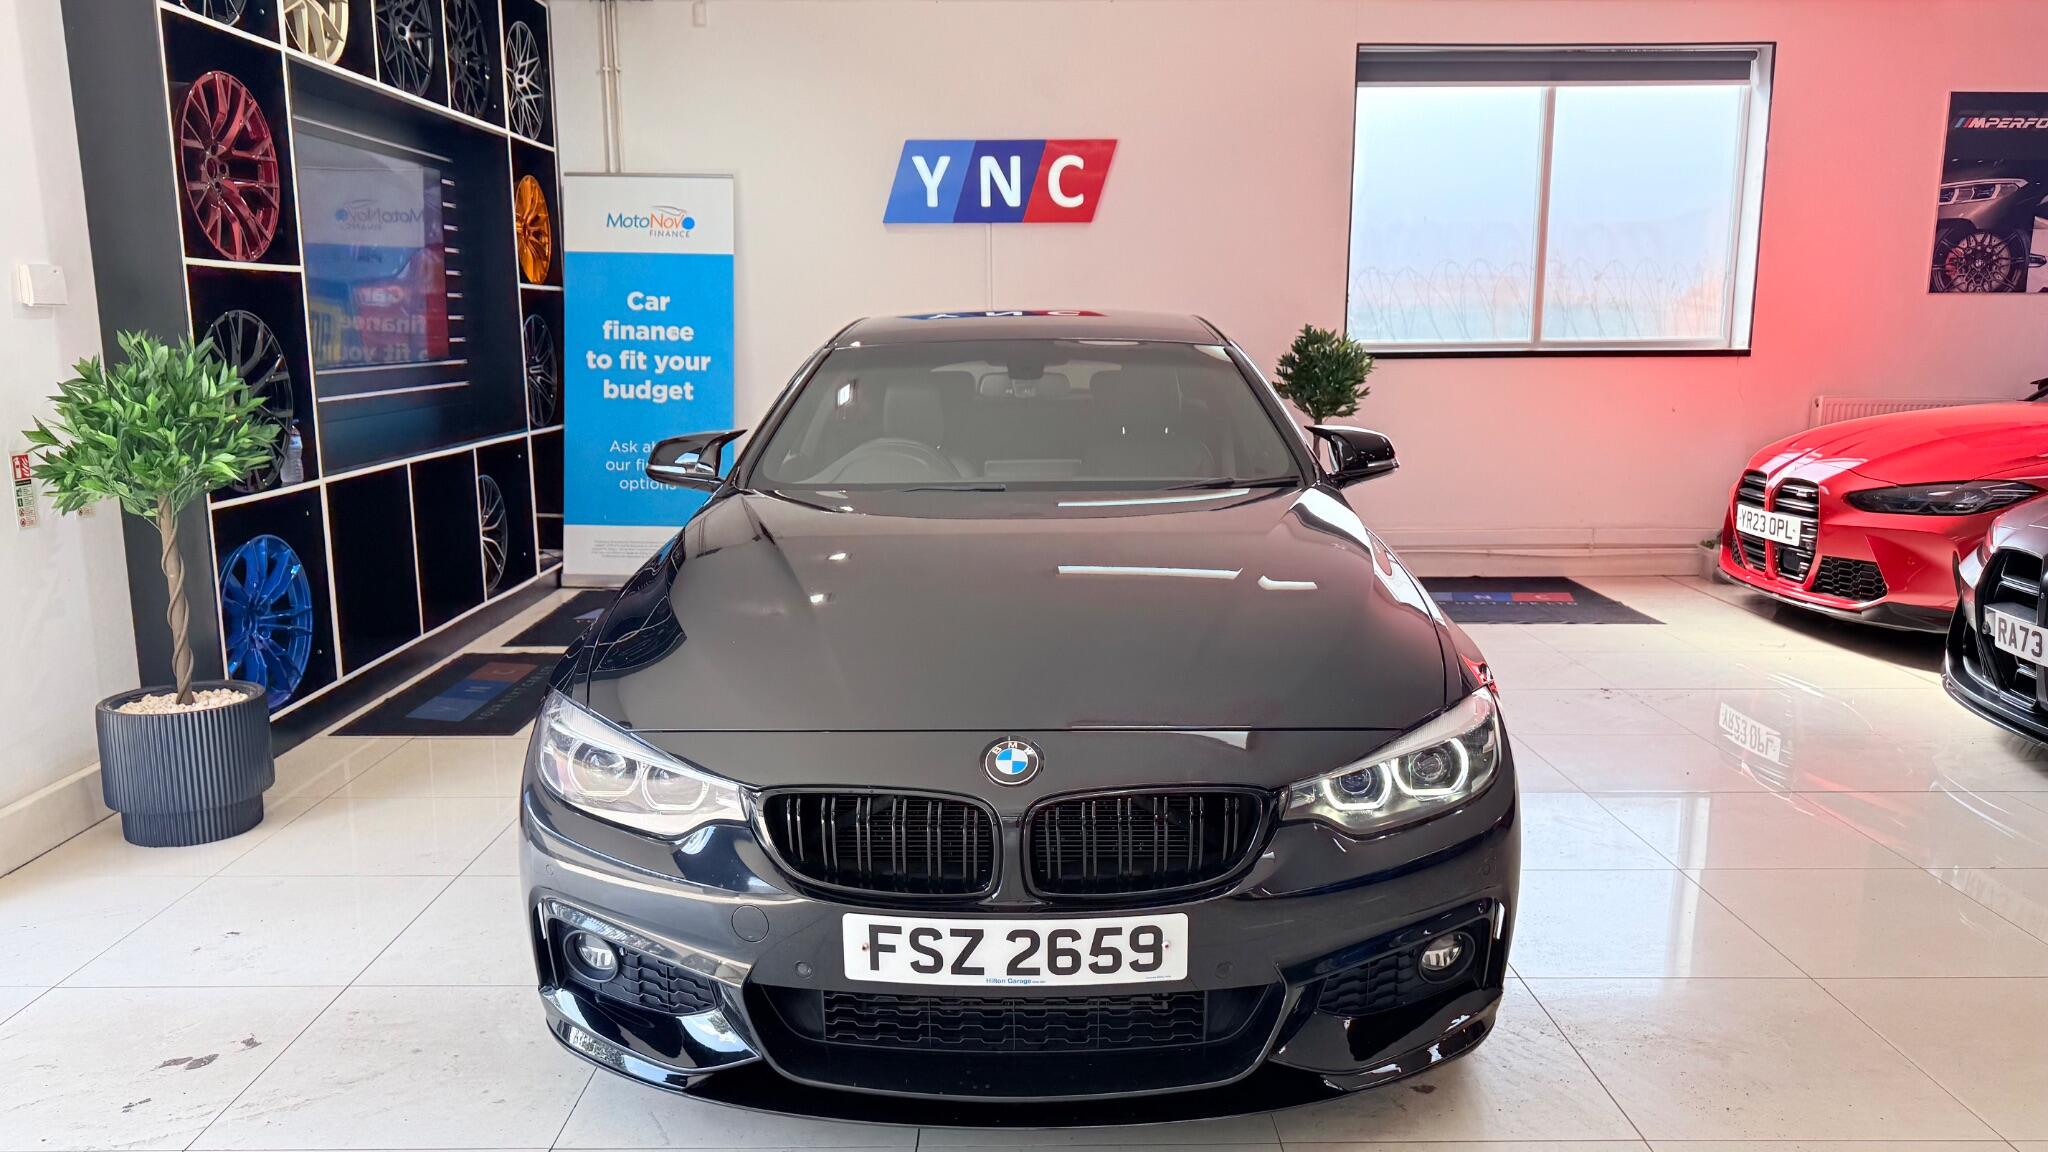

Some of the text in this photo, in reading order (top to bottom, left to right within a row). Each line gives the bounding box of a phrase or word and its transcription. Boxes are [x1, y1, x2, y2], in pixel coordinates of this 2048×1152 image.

[911, 154, 1084, 208] YNC
[649, 230, 690, 238] FINANCE
[626, 291, 671, 311] Car
[602, 320, 694, 341] finance
[586, 350, 711, 374] to fit your
[603, 379, 694, 403] budget
[609, 440, 637, 453] Ask
[605, 461, 631, 471] our
[1741, 509, 1793, 540] YR23 OPL
[1998, 617, 2043, 658] RA73
[991, 741, 1037, 756] BMW
[868, 924, 1164, 976] FSZ 2659
